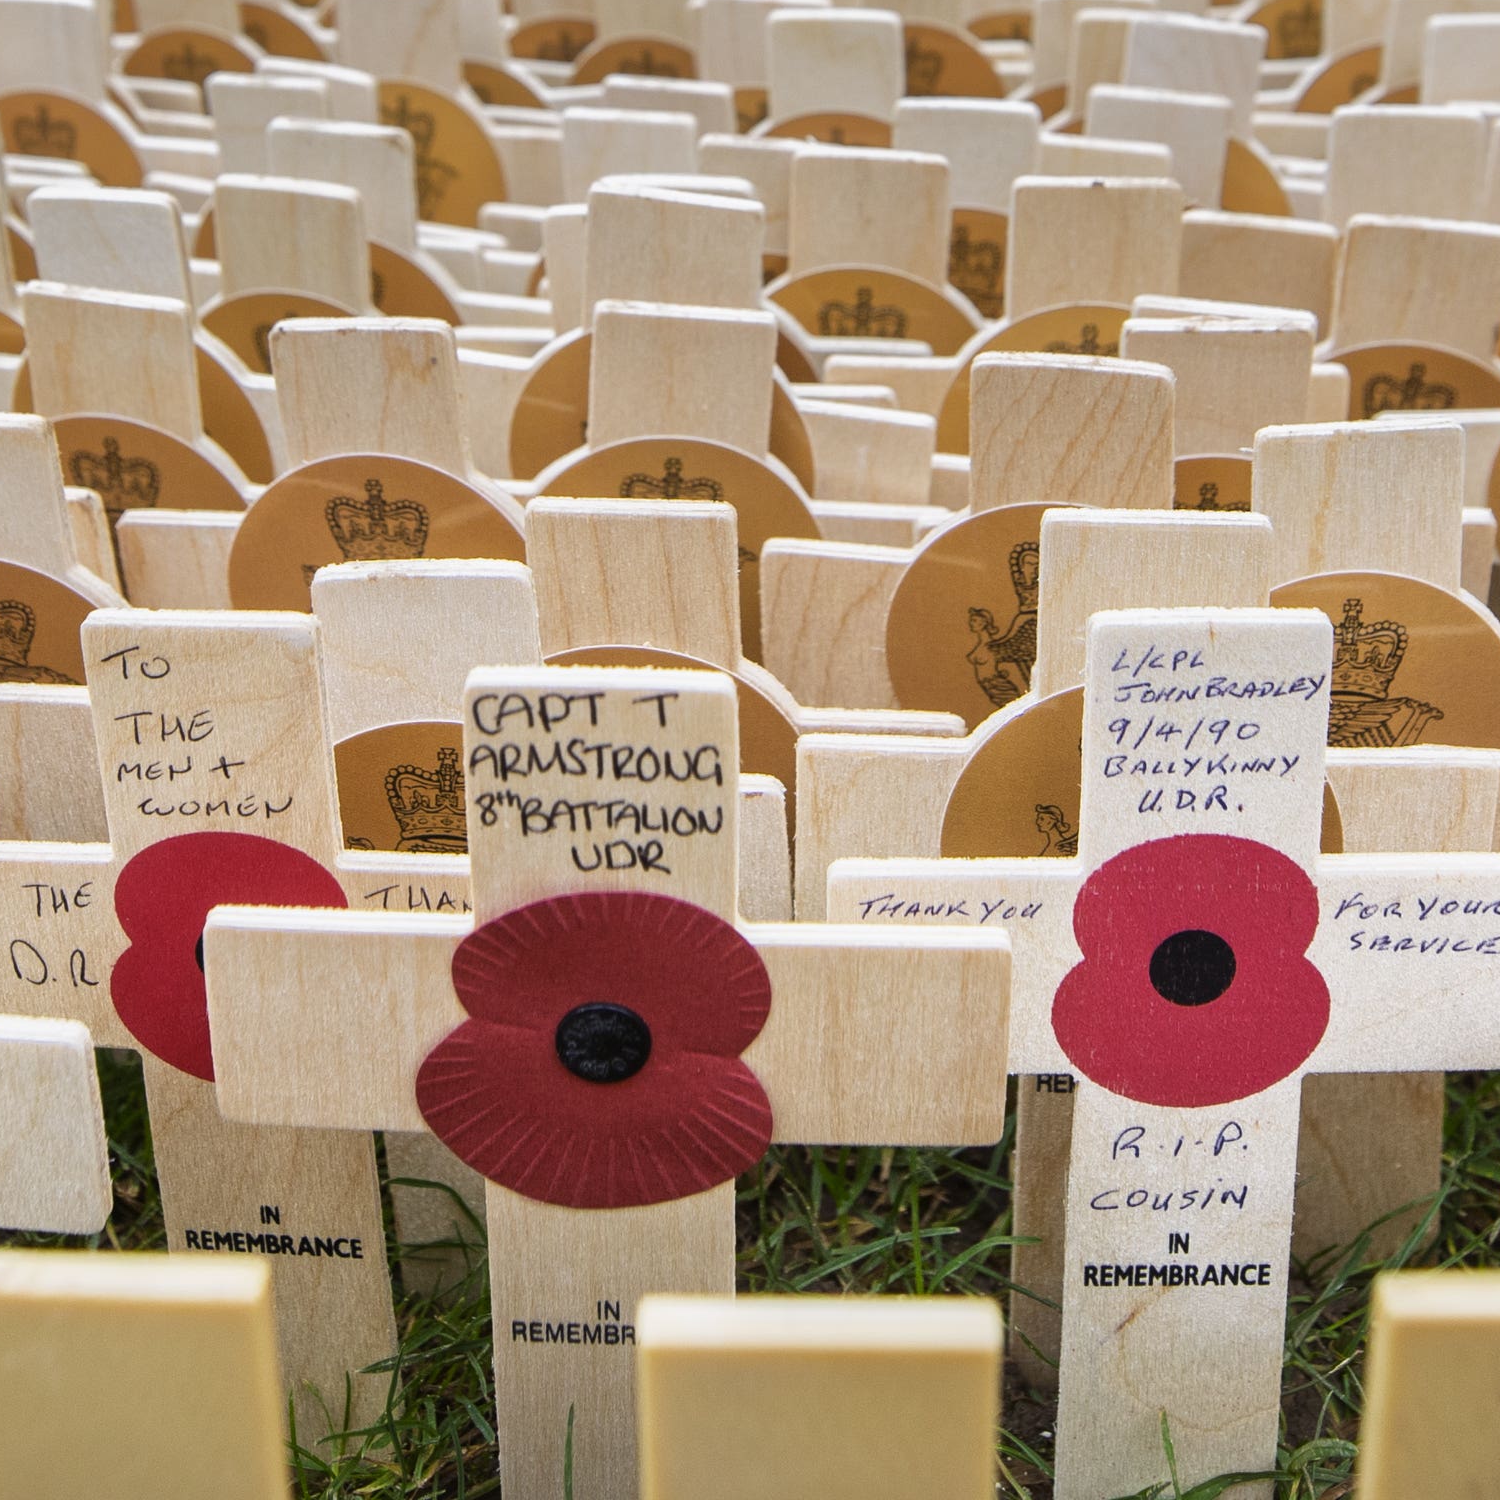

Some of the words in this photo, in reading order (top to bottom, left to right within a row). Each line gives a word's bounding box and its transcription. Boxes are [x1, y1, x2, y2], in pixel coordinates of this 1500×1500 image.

[101, 645, 171, 680] TO
[113, 709, 215, 746] THE
[472, 693, 606, 735] CAPT
[632, 693, 680, 728] T
[1107, 715, 1261, 750] 9/4/90
[117, 755, 193, 783] MEN
[469, 738, 724, 787] ARMSTRONG
[137, 795, 294, 819] WOMEN
[520, 798, 724, 837] BATTALION
[571, 839, 672, 876] UDR
[20, 880, 95, 918] THE
[858, 893, 971, 921] THANK
[979, 899, 1044, 925] YOU
[259, 1205, 281, 1225] IN
[184, 1229, 364, 1260] REMEMBRANCE
[1168, 1232, 1191, 1255] IN
[1083, 1263, 1273, 1288] REMEMBRANCE
[596, 1299, 621, 1322] IN
[511, 1320, 637, 1346] REMEMBR
